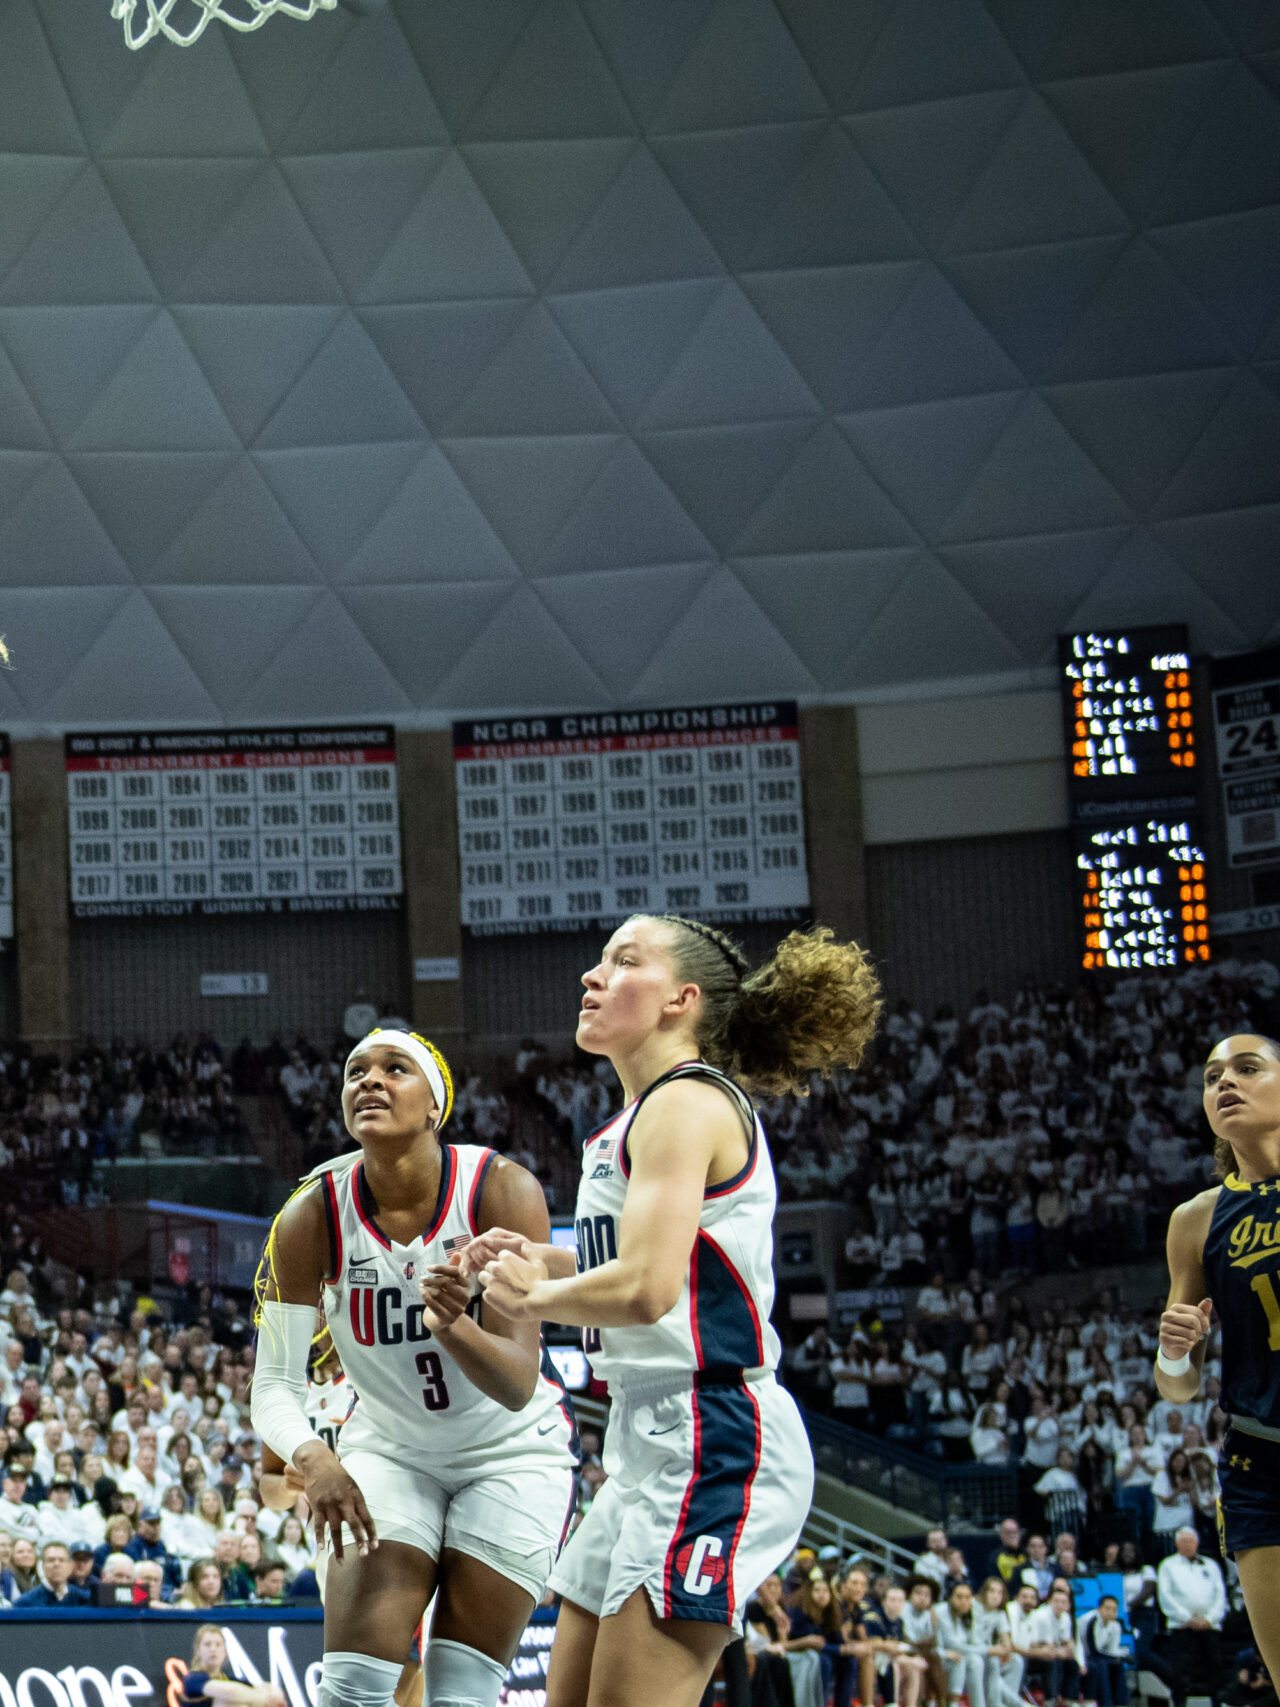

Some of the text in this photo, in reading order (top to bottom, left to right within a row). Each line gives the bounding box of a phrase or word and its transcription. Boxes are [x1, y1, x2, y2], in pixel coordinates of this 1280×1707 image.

[472, 705, 778, 742] NCAA CHAMPIONSHIP
[1226, 718, 1278, 758] 24
[98, 750, 365, 770] TOURNAMENT CHAMPIONS
[74, 902, 193, 917] CONNECTICUT
[288, 896, 400, 911] BASKETBALL
[415, 1351, 450, 1412] 3
